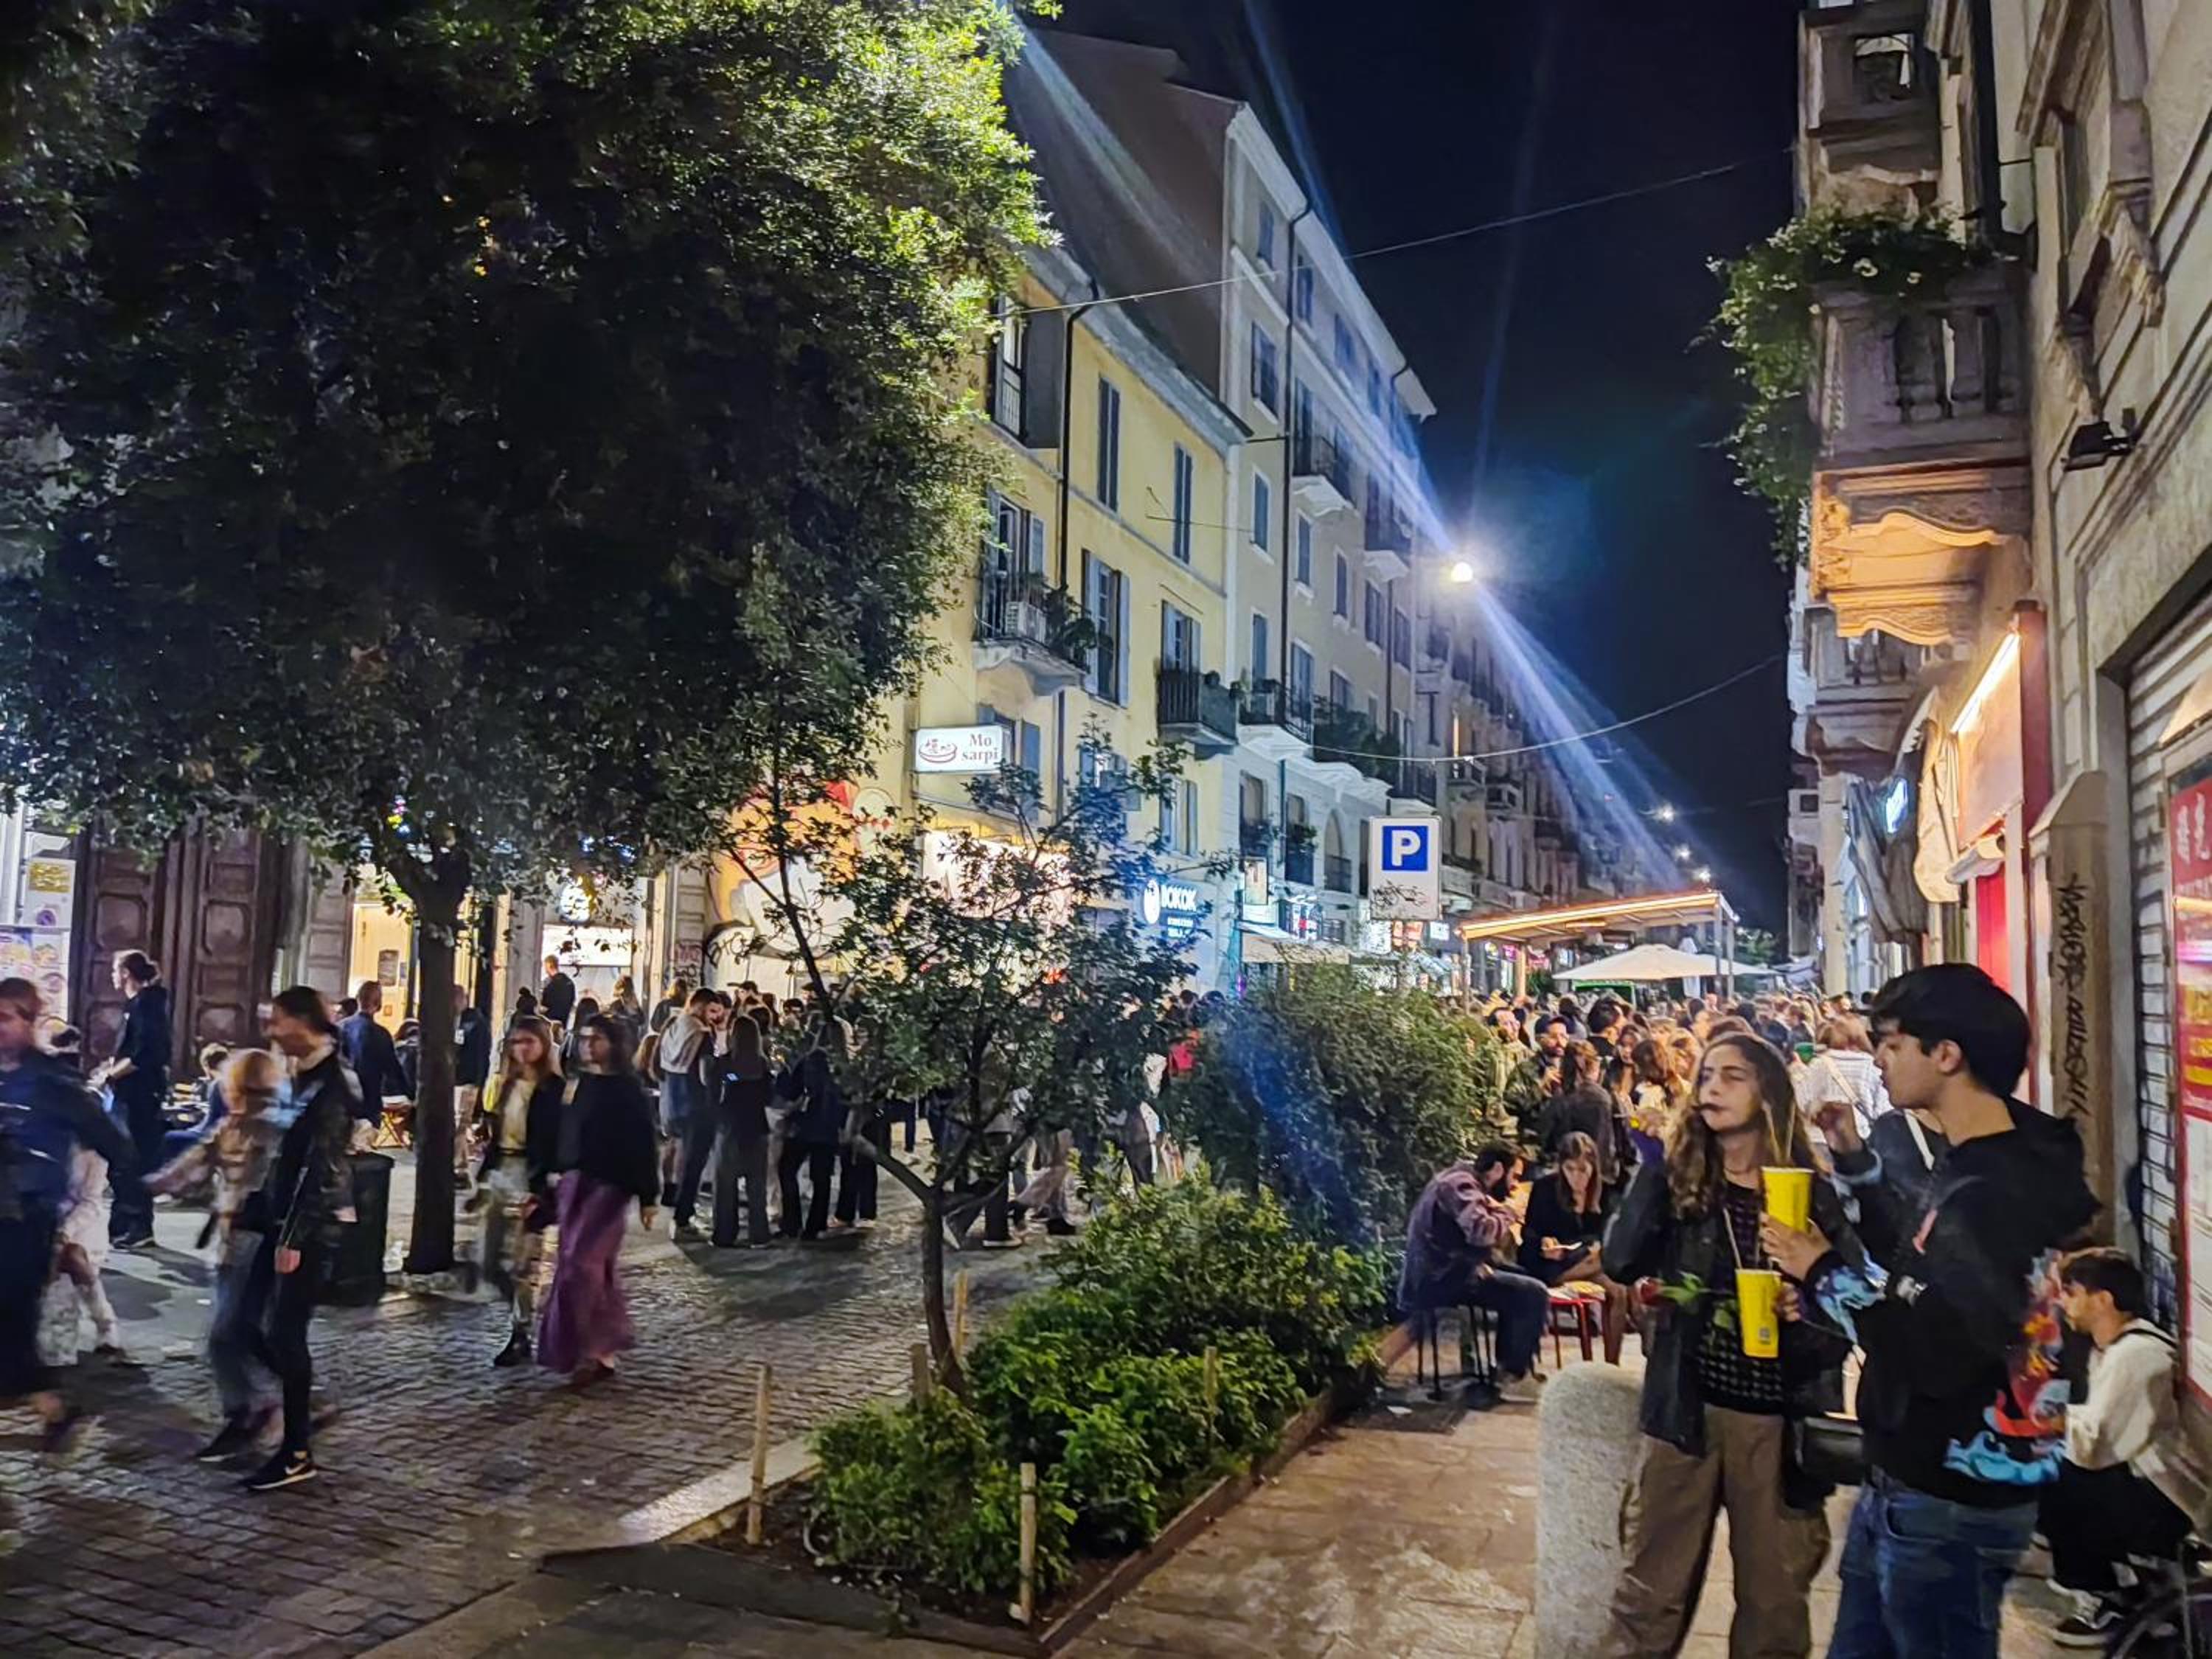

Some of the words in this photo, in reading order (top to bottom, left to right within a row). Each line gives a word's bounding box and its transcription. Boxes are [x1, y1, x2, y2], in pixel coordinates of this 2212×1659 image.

[970, 734, 992, 747] Mo
[961, 748, 998, 764] sarpi
[1391, 830, 1421, 866] P
